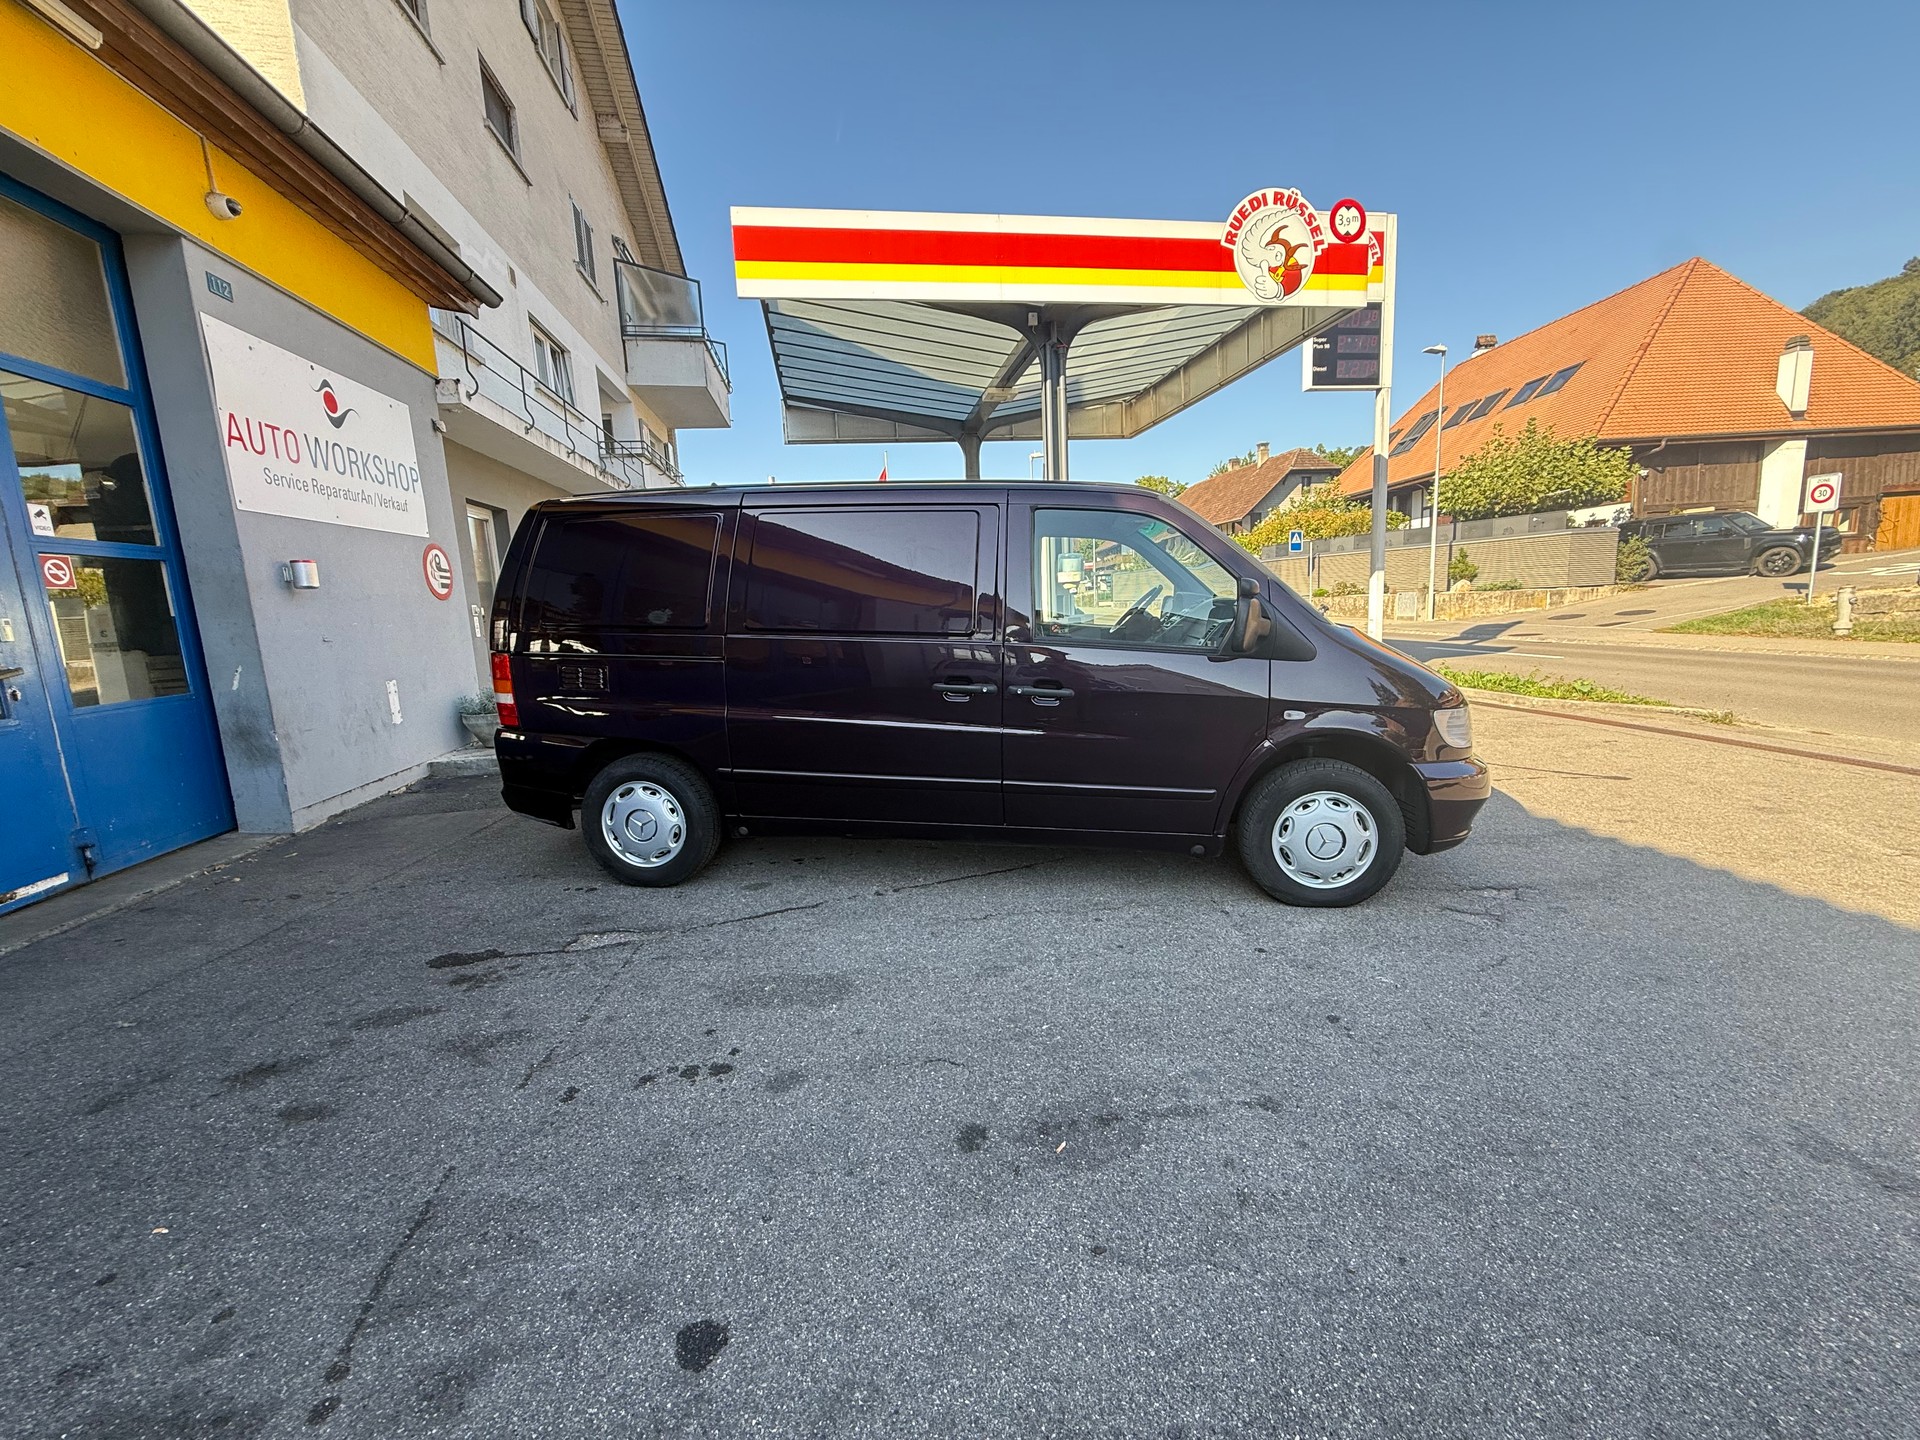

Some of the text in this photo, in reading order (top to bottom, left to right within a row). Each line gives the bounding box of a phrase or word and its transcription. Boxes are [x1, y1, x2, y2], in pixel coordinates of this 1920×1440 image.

[1224, 190, 1325, 252] RUEDI RÜSSEL
[211, 276, 231, 298] 112
[227, 412, 419, 493] AUTO WORKSHOP
[263, 467, 309, 492] Service
[1817, 489, 1828, 498] 30
